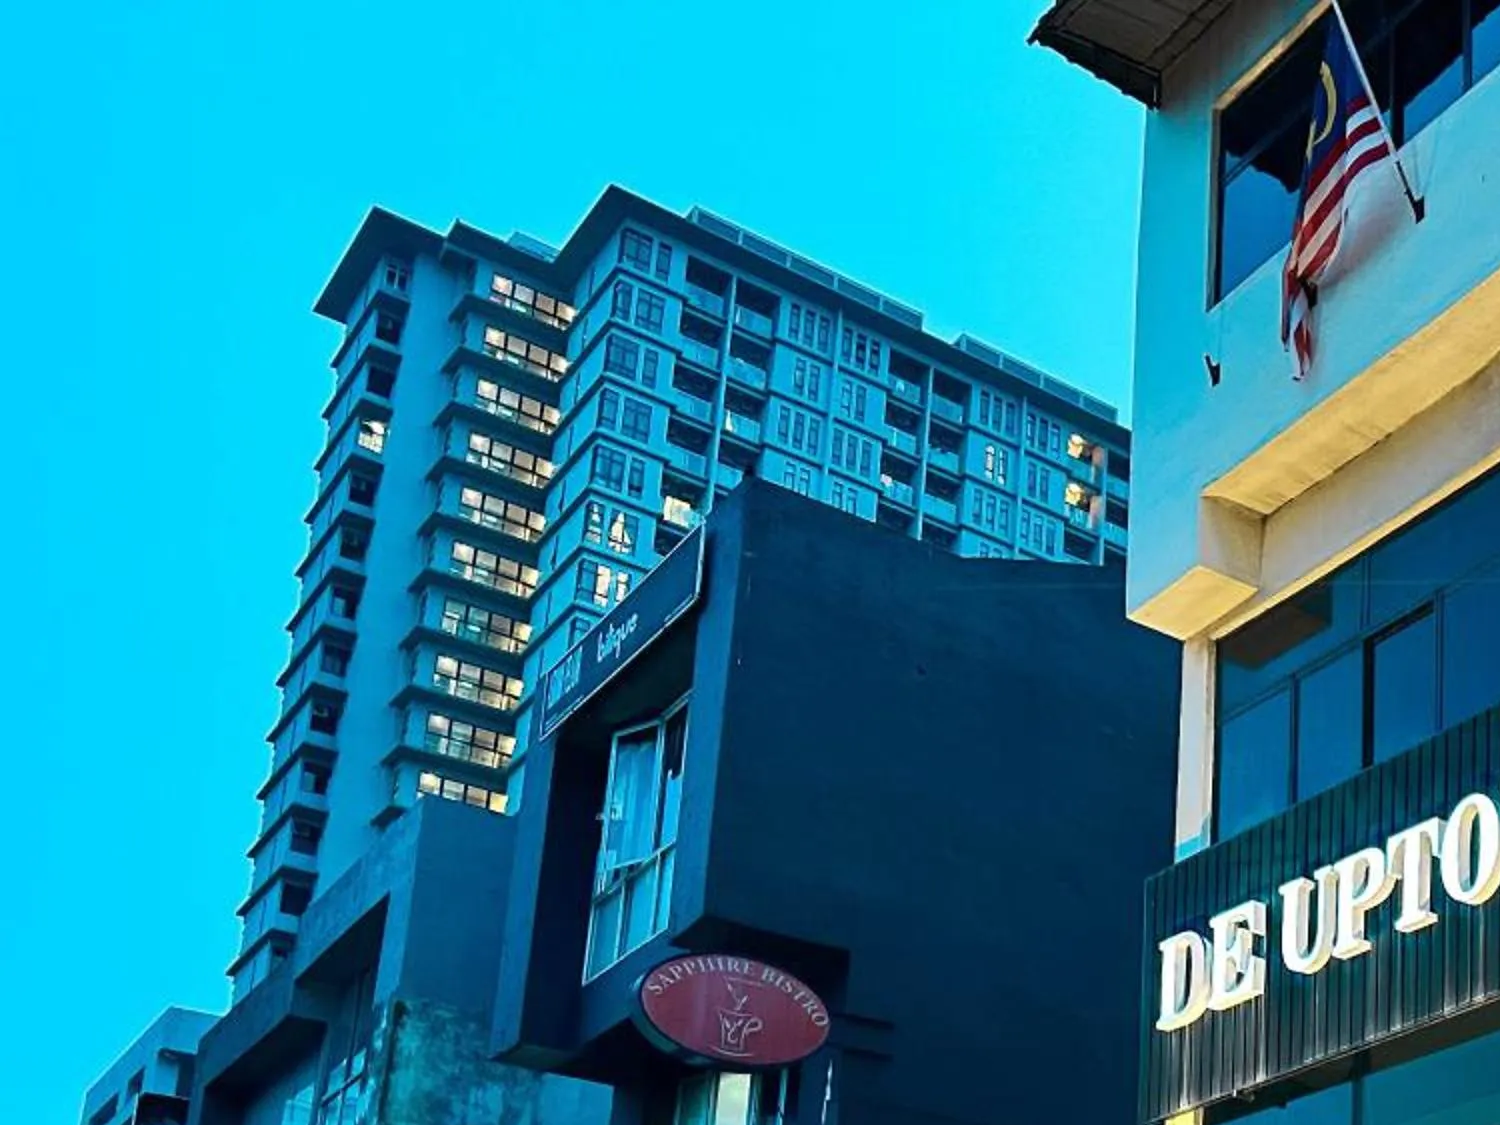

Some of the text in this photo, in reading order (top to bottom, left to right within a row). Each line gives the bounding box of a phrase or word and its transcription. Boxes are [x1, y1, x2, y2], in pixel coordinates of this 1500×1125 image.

[648, 956, 829, 1027] SAPPHIRE BISTRO
[1156, 899, 1267, 1032] DE
